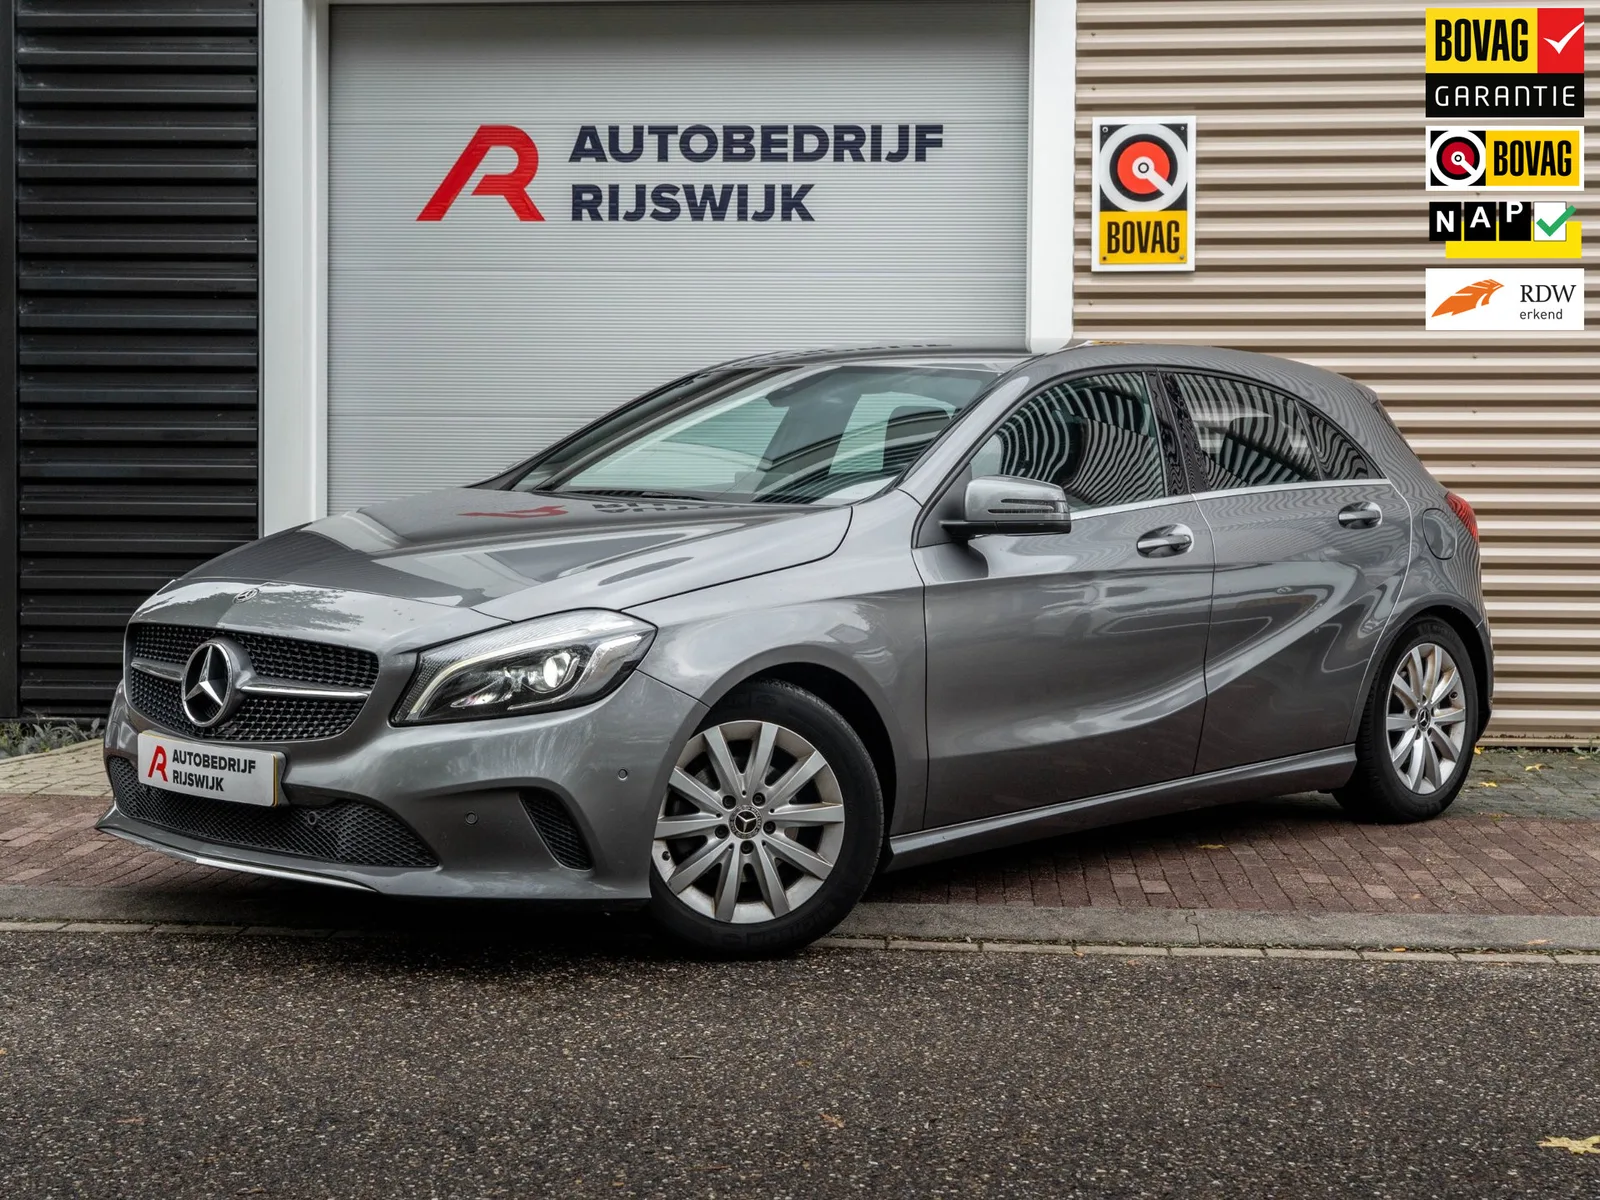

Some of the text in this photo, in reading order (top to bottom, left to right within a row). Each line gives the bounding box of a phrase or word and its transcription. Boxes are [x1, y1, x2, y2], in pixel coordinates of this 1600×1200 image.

[568, 124, 944, 163] AUTOBEDRIJF
[571, 183, 816, 222] RIJSWIJK
[1106, 220, 1181, 254] BOVAG
[172, 749, 256, 775] AUTOBEDRIJF
[172, 770, 225, 792] RIJSWIJK
